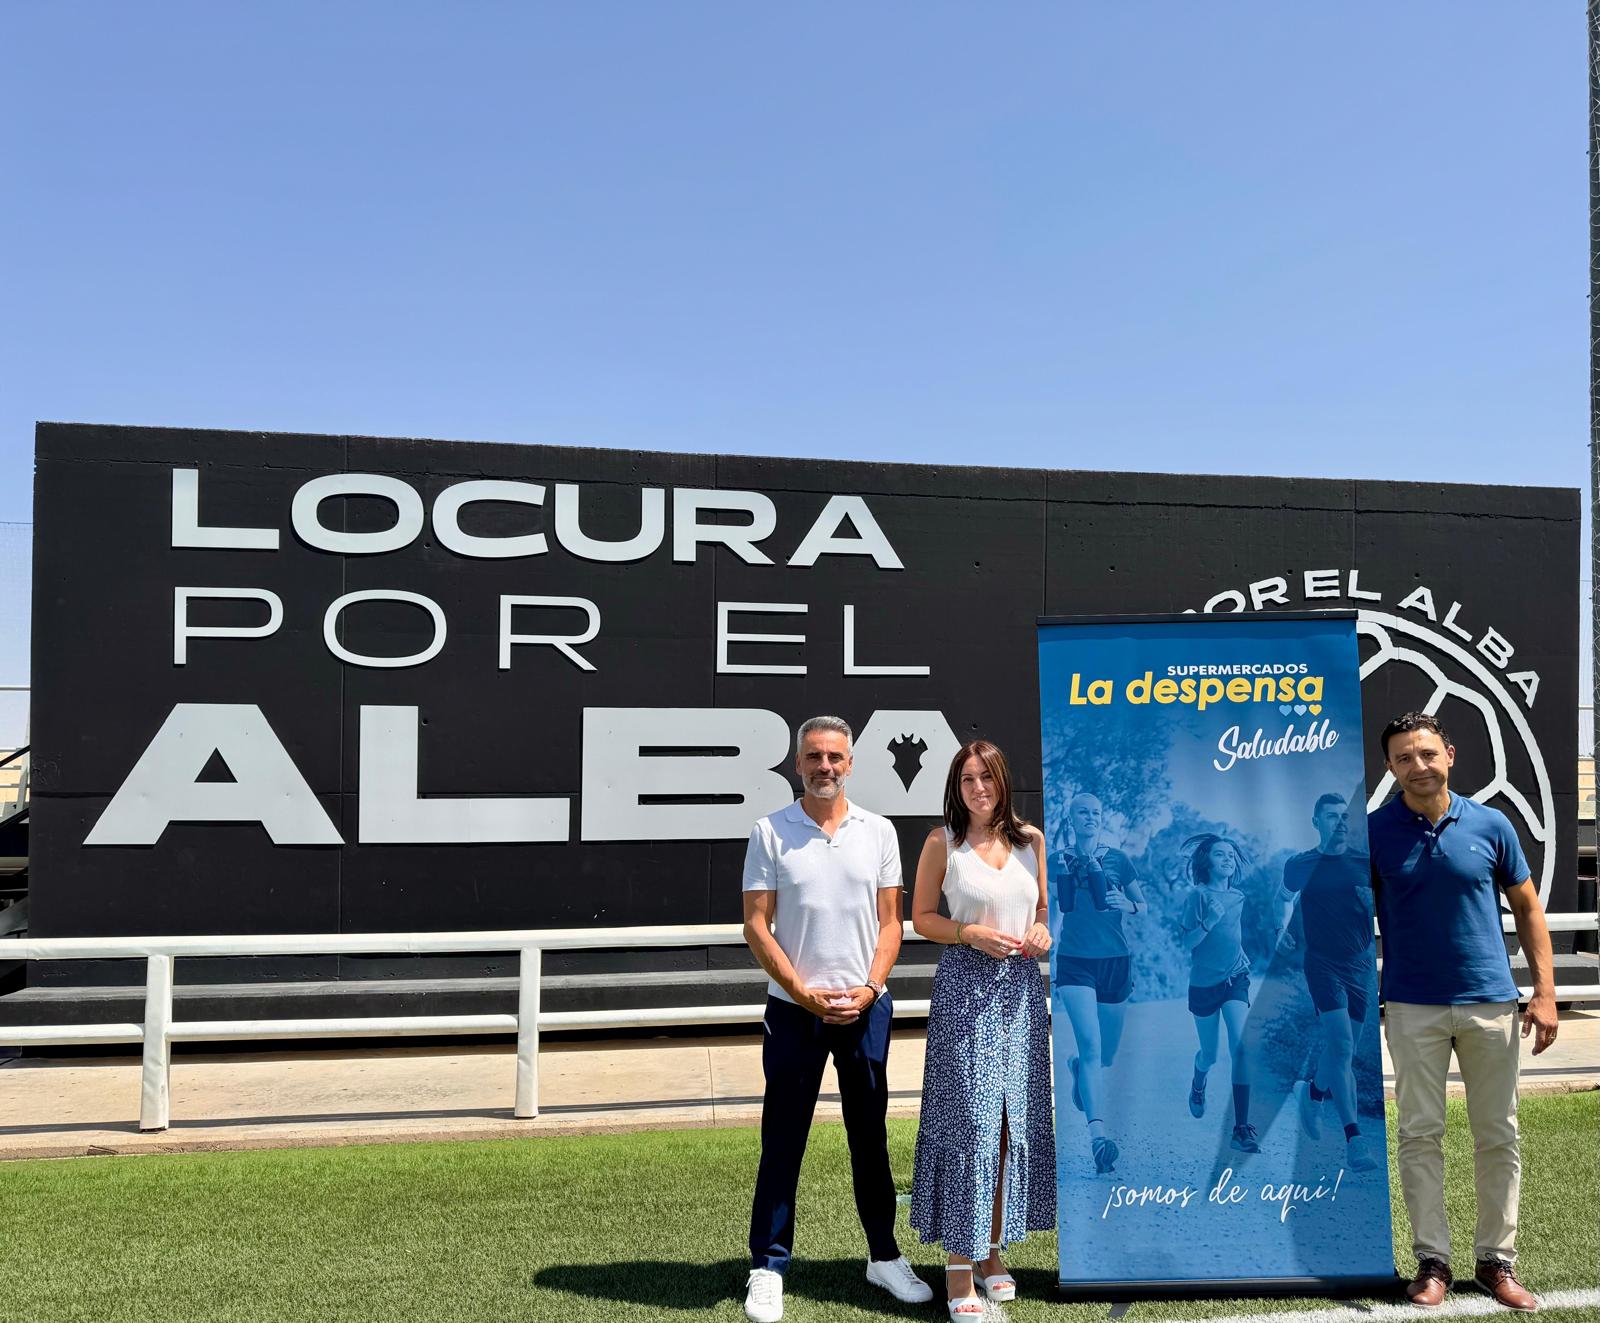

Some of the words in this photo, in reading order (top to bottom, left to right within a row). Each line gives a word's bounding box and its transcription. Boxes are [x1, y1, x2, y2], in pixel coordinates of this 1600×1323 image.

[171, 468, 904, 570] LOCURA
[173, 586, 602, 671] POR
[715, 602, 932, 676] EL
[1181, 576, 1290, 613] OR
[1304, 569, 1382, 600] EL
[1397, 585, 1541, 709] ALBA
[1069, 673, 1114, 705] La
[1125, 671, 1324, 710] despensa
[1167, 663, 1308, 676] SUPERMERCADOS
[1213, 718, 1340, 771] Saludable
[1102, 1184, 1198, 1219] ¡somos
[1208, 1168, 1248, 1205] de
[1260, 1168, 1344, 1222] aquí!
